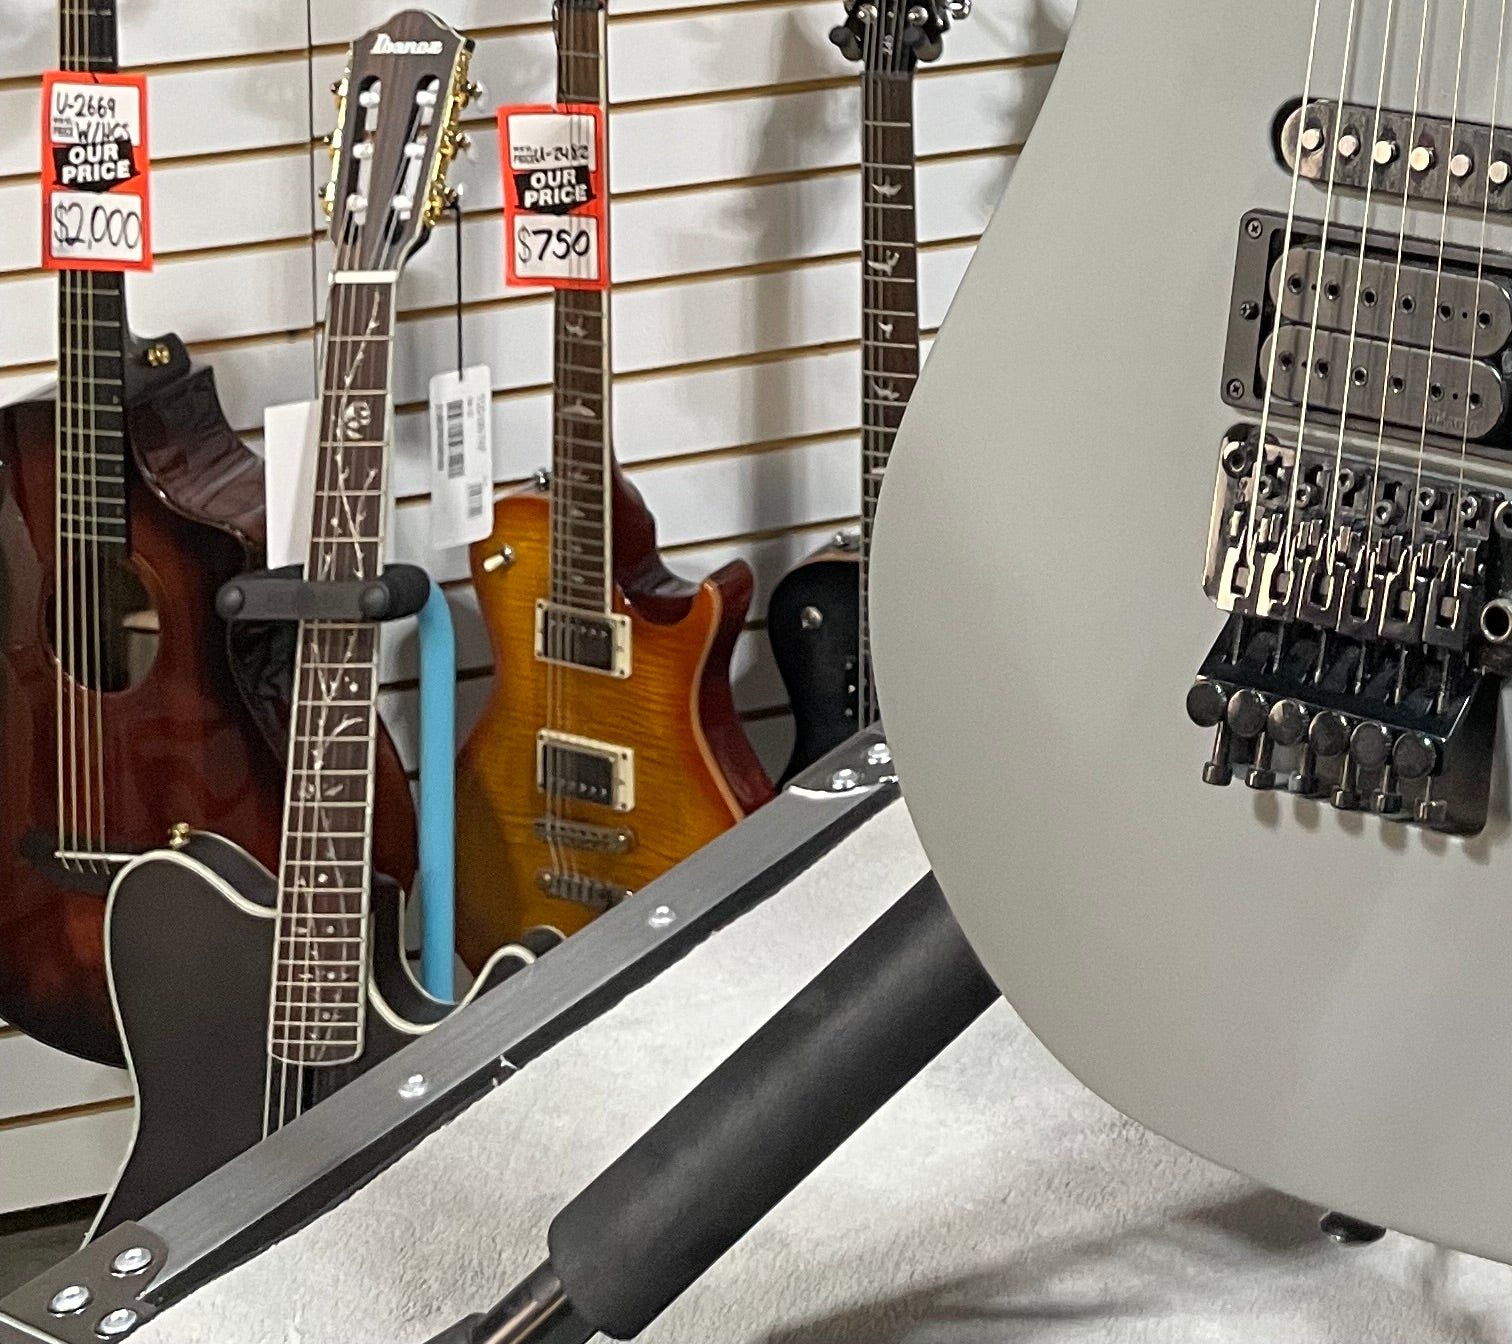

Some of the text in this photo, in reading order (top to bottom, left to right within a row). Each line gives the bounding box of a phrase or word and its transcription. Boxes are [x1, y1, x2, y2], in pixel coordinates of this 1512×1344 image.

[369, 33, 443, 55] Ibanez
[56, 90, 117, 119] U-2669
[68, 143, 119, 166] OUR
[61, 159, 131, 185] PRICE
[530, 169, 577, 189] OUR
[524, 184, 588, 209] PRICE
[53, 200, 142, 251] $2,000
[517, 224, 590, 264] $750
